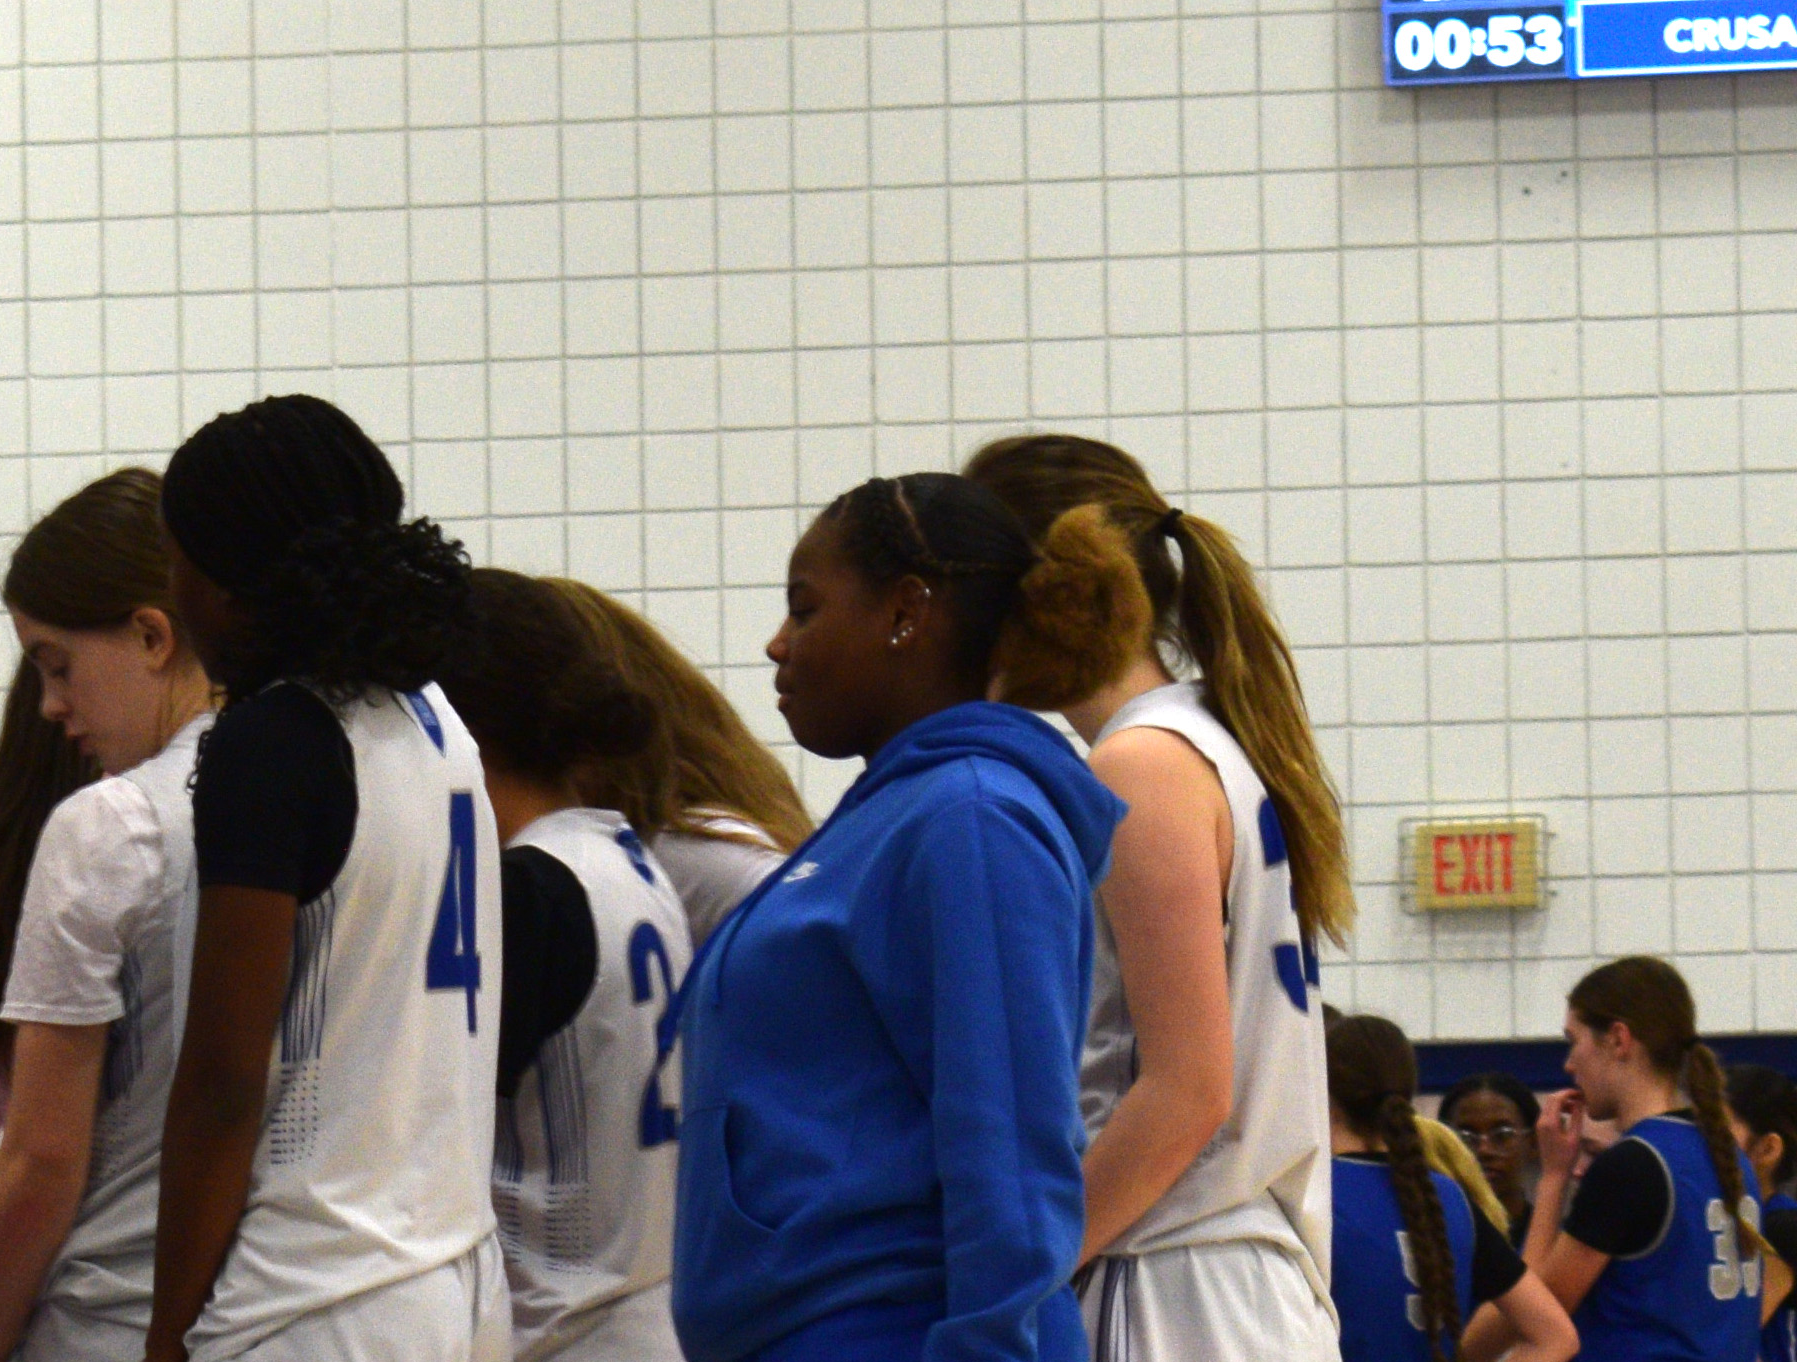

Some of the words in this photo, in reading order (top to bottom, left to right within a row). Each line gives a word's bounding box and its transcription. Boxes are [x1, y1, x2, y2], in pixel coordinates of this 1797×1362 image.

[1395, 14, 1563, 71] 00:53
[1663, 14, 1797, 53] CRUSA
[1433, 833, 1516, 896] EXIT
[426, 791, 480, 1037] 4
